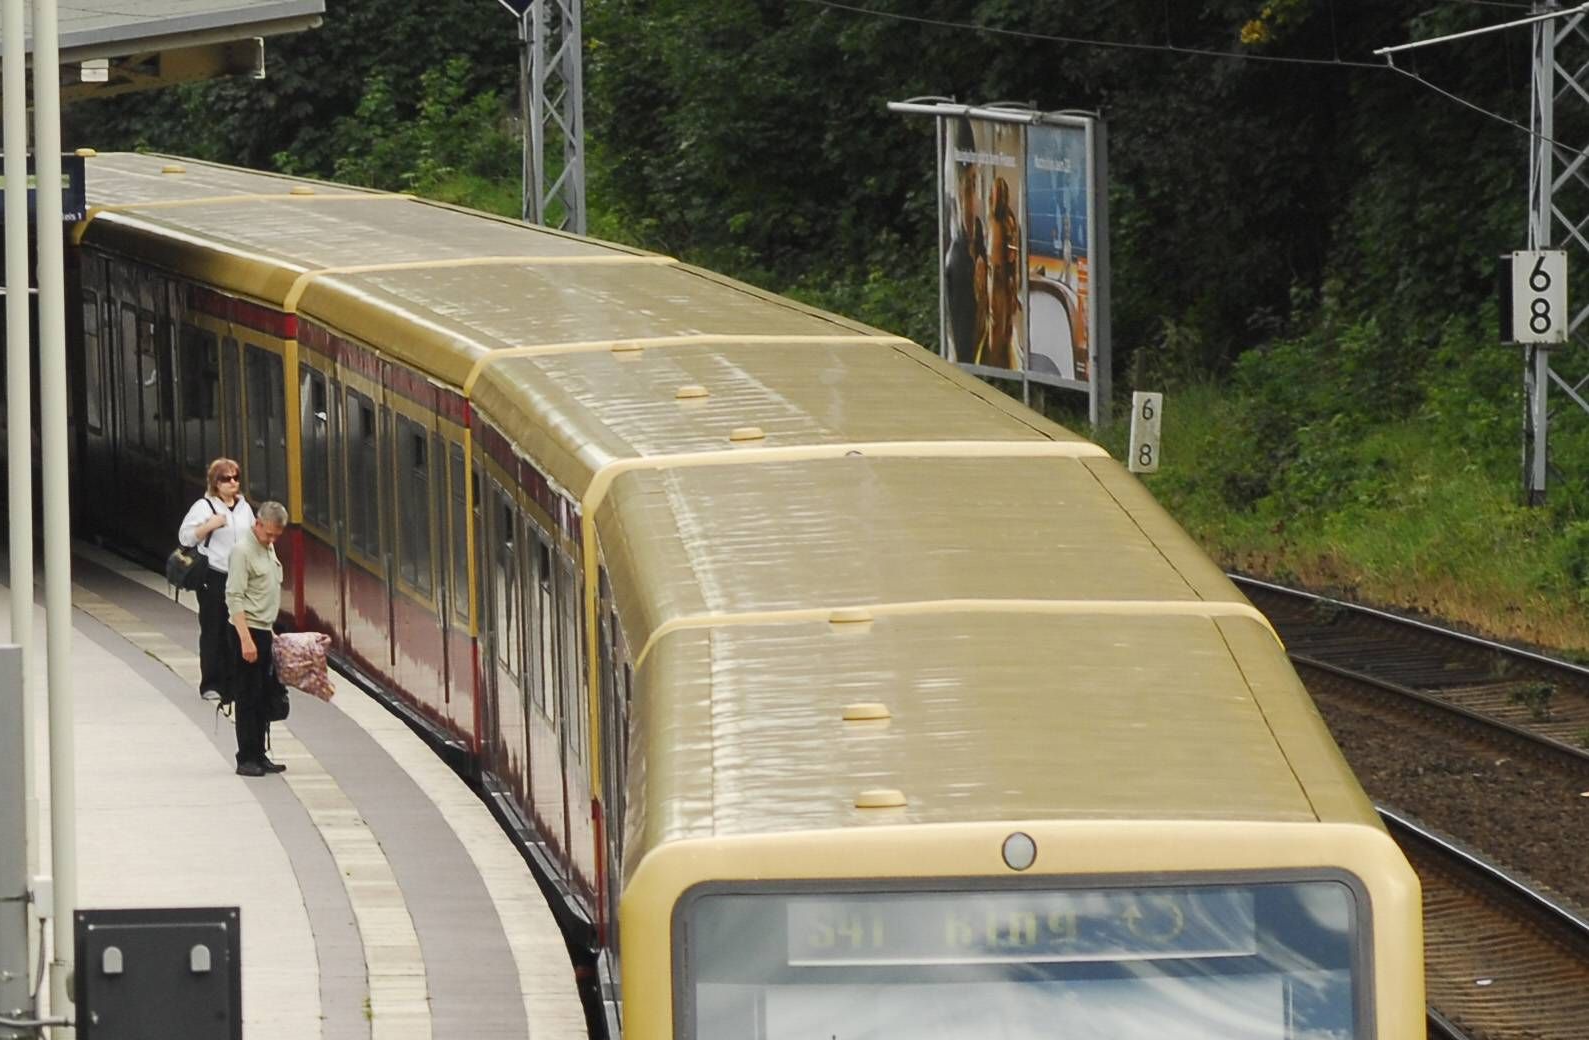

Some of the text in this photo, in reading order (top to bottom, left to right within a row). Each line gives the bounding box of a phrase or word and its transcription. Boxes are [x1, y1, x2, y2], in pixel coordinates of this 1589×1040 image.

[1529, 255, 1552, 293] 6
[1529, 297, 1552, 335] 8
[1142, 398, 1154, 421] 6
[1139, 443, 1152, 467] 8
